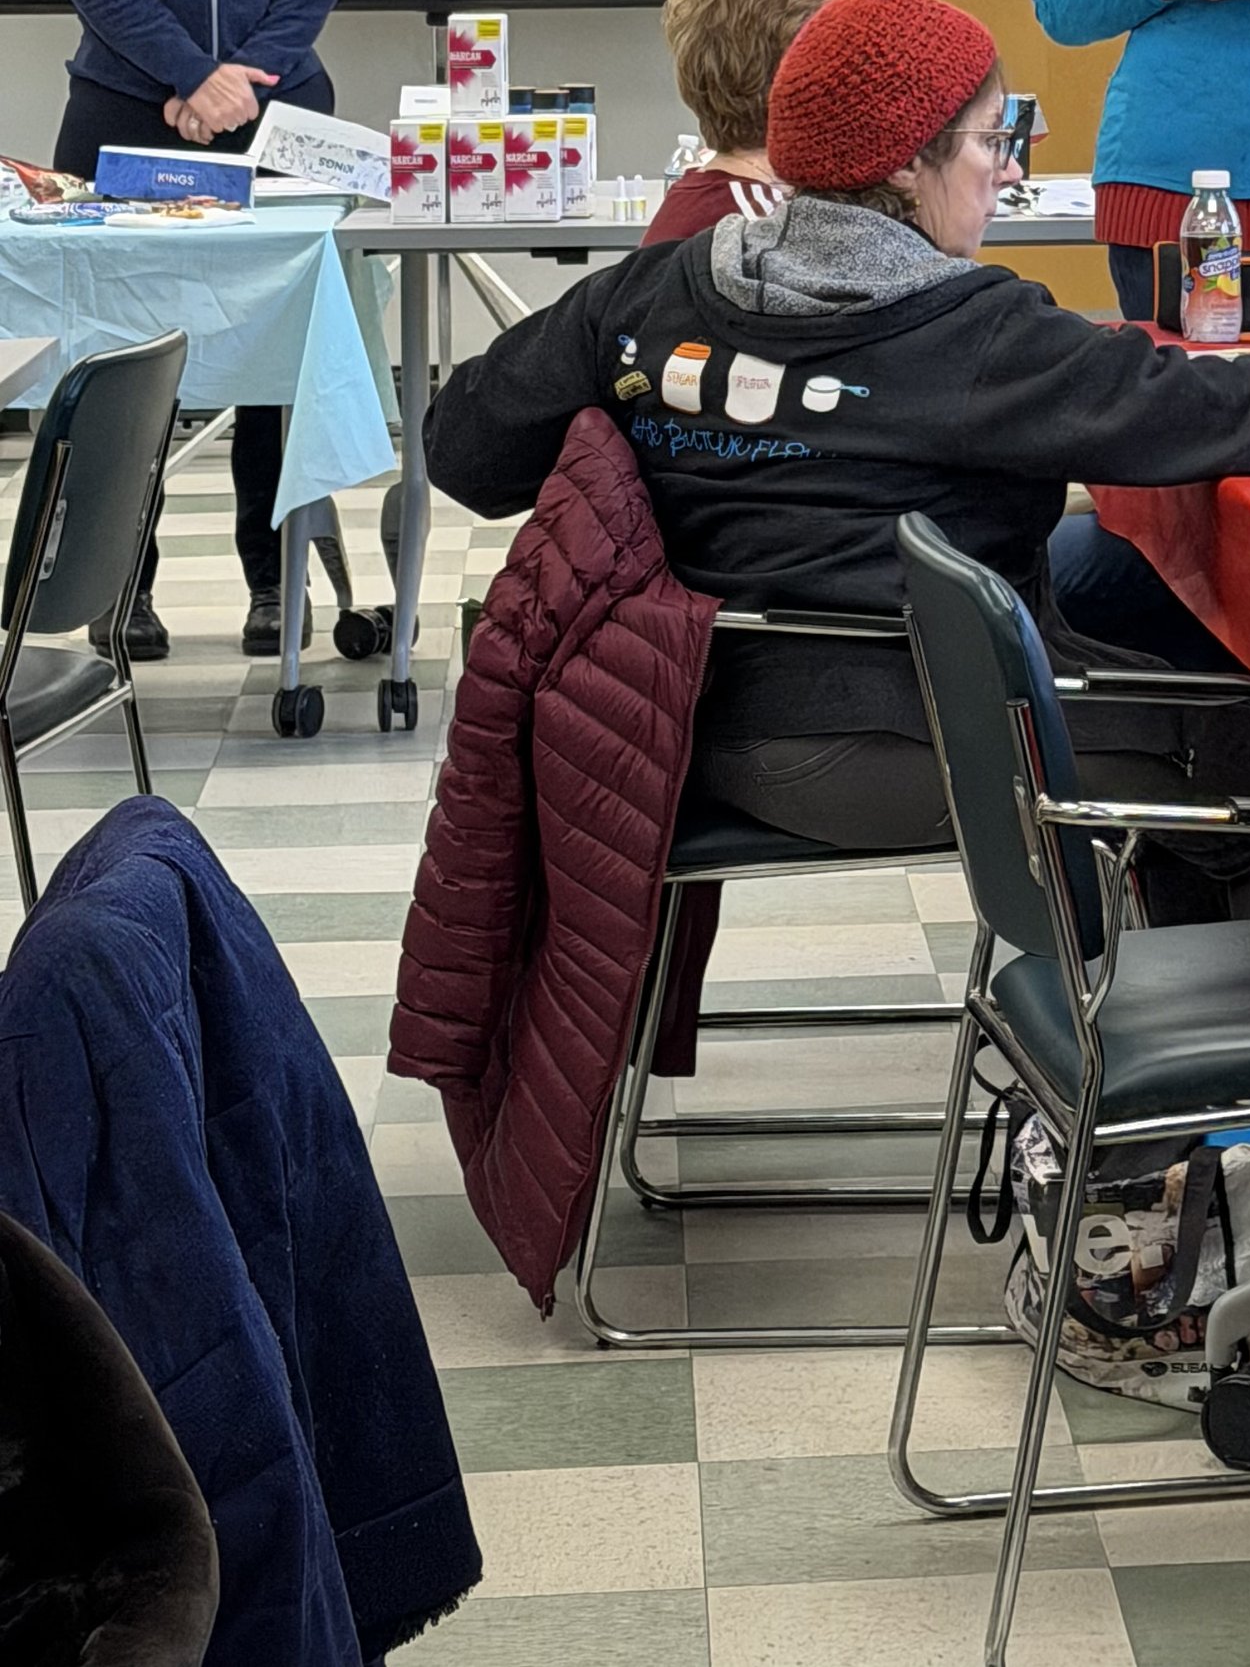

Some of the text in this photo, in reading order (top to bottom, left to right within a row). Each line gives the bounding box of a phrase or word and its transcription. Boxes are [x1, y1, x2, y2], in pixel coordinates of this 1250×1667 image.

[505, 152, 537, 163] NARCAN
[318, 156, 354, 175] KINGS
[157, 172, 195, 186] KINGS
